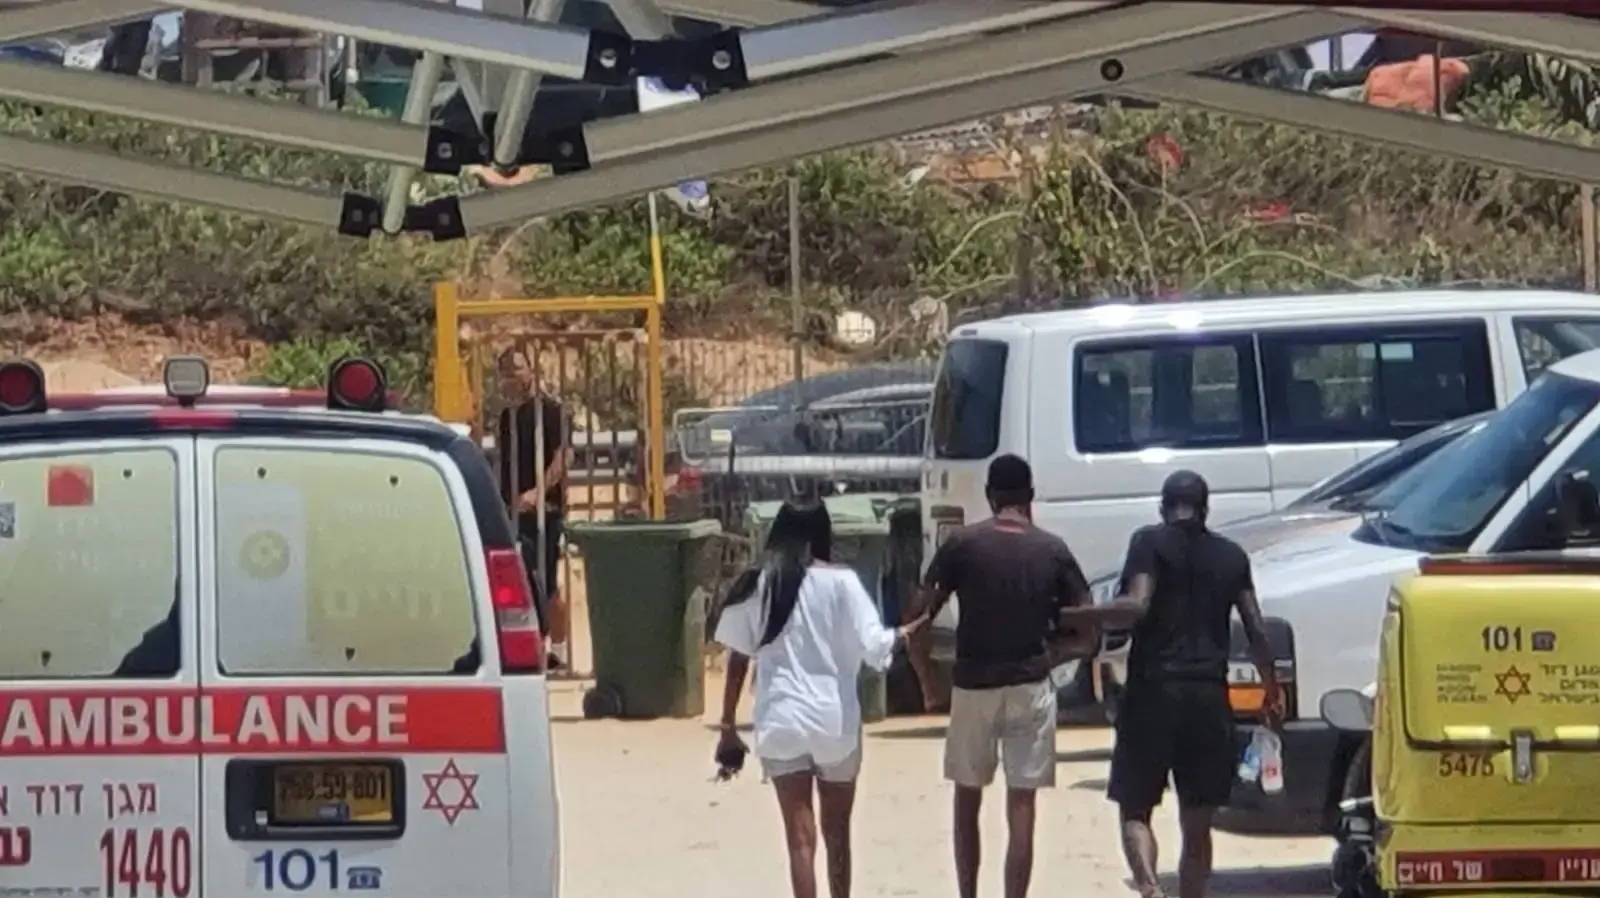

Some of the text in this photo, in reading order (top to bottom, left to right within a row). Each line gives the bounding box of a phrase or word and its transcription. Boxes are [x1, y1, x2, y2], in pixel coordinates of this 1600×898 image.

[1482, 625, 1521, 652] 101
[1, 695, 409, 747] AMBULANCE
[1440, 754, 1494, 777] 5475
[26, 784, 84, 816] דוד
[102, 783, 156, 820] מגן
[100, 826, 191, 898] 1440
[253, 848, 339, 891] 101
[1398, 861, 1443, 882] חיים
[1452, 860, 1483, 881] של
